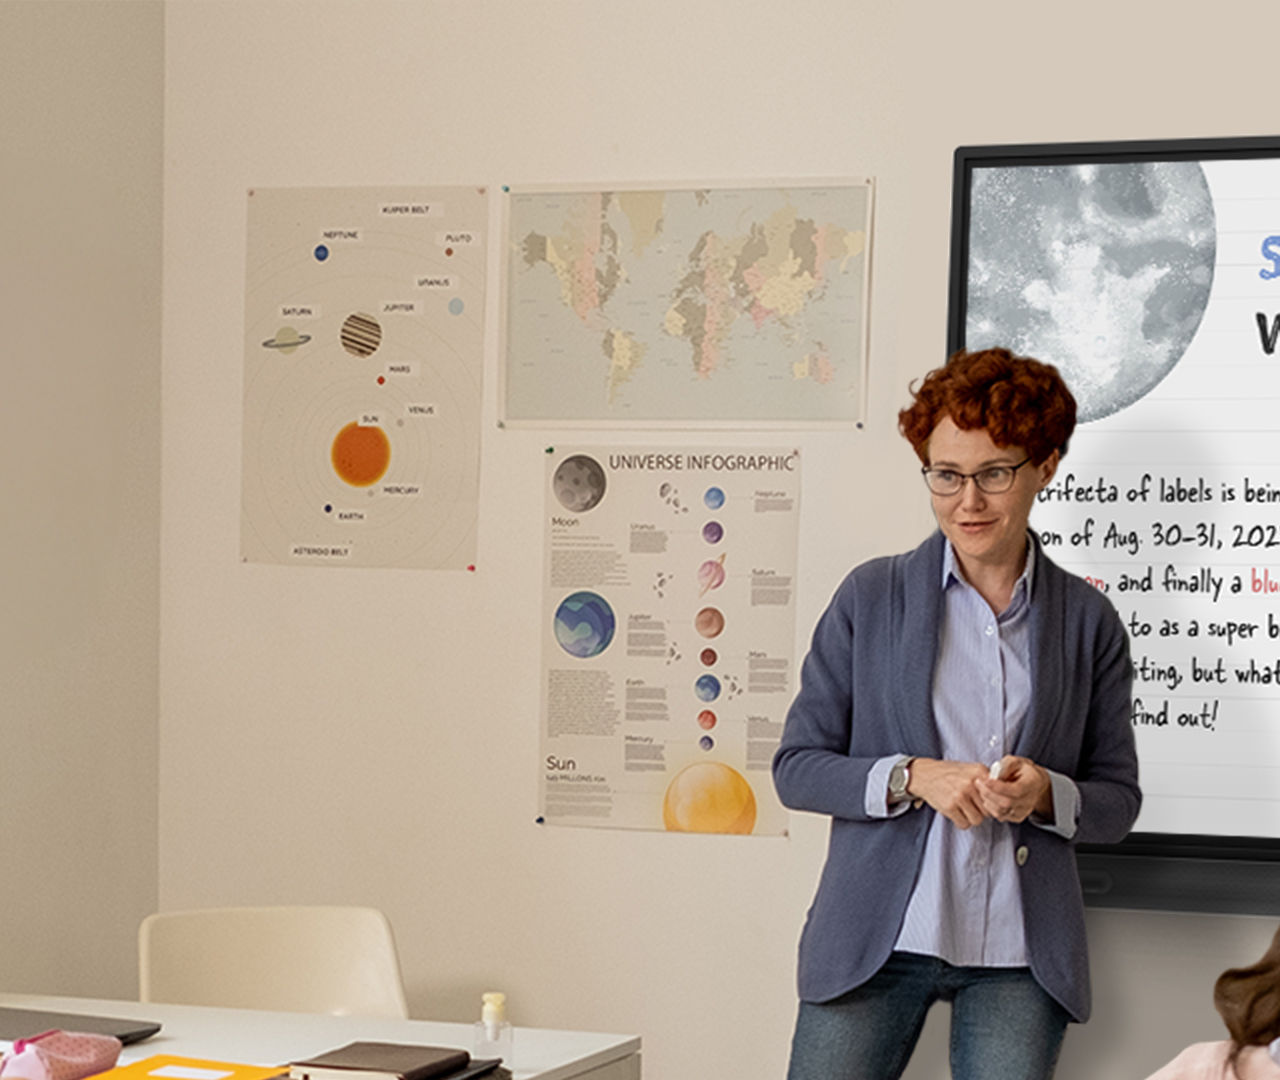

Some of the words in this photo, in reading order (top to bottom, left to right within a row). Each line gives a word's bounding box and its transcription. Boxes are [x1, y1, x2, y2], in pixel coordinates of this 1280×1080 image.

[411, 205, 430, 214] BELT
[323, 231, 359, 240] NEPTUNE
[445, 233, 473, 243] PLUTO
[417, 278, 450, 287] URANUS
[281, 307, 313, 316] SATURN
[383, 303, 415, 312] JUPITER
[388, 365, 411, 374] MARS
[407, 406, 434, 415] VENUS
[362, 414, 379, 424] SUN
[609, 454, 684, 471] UNIVERSE
[686, 455, 795, 471] INFOGRAPHIC
[383, 486, 419, 495] MERCURY
[1126, 473, 1151, 502] of
[1160, 477, 1212, 503] labels
[1222, 483, 1235, 502] is
[338, 512, 365, 521] EARTH
[551, 516, 580, 528] Moon
[1071, 518, 1094, 546] of
[1104, 522, 1142, 555] Aug.
[331, 546, 348, 555] BELT
[1118, 566, 1153, 592] and
[1162, 564, 1223, 602] finally
[1231, 576, 1242, 594] a
[1129, 611, 1152, 637] to
[1159, 620, 1179, 637] as
[1187, 620, 1199, 637] a
[1208, 622, 1259, 646] super
[1192, 657, 1227, 684] but
[1131, 698, 1169, 726] find
[1177, 700, 1218, 731] out!
[545, 754, 577, 771] Sun
